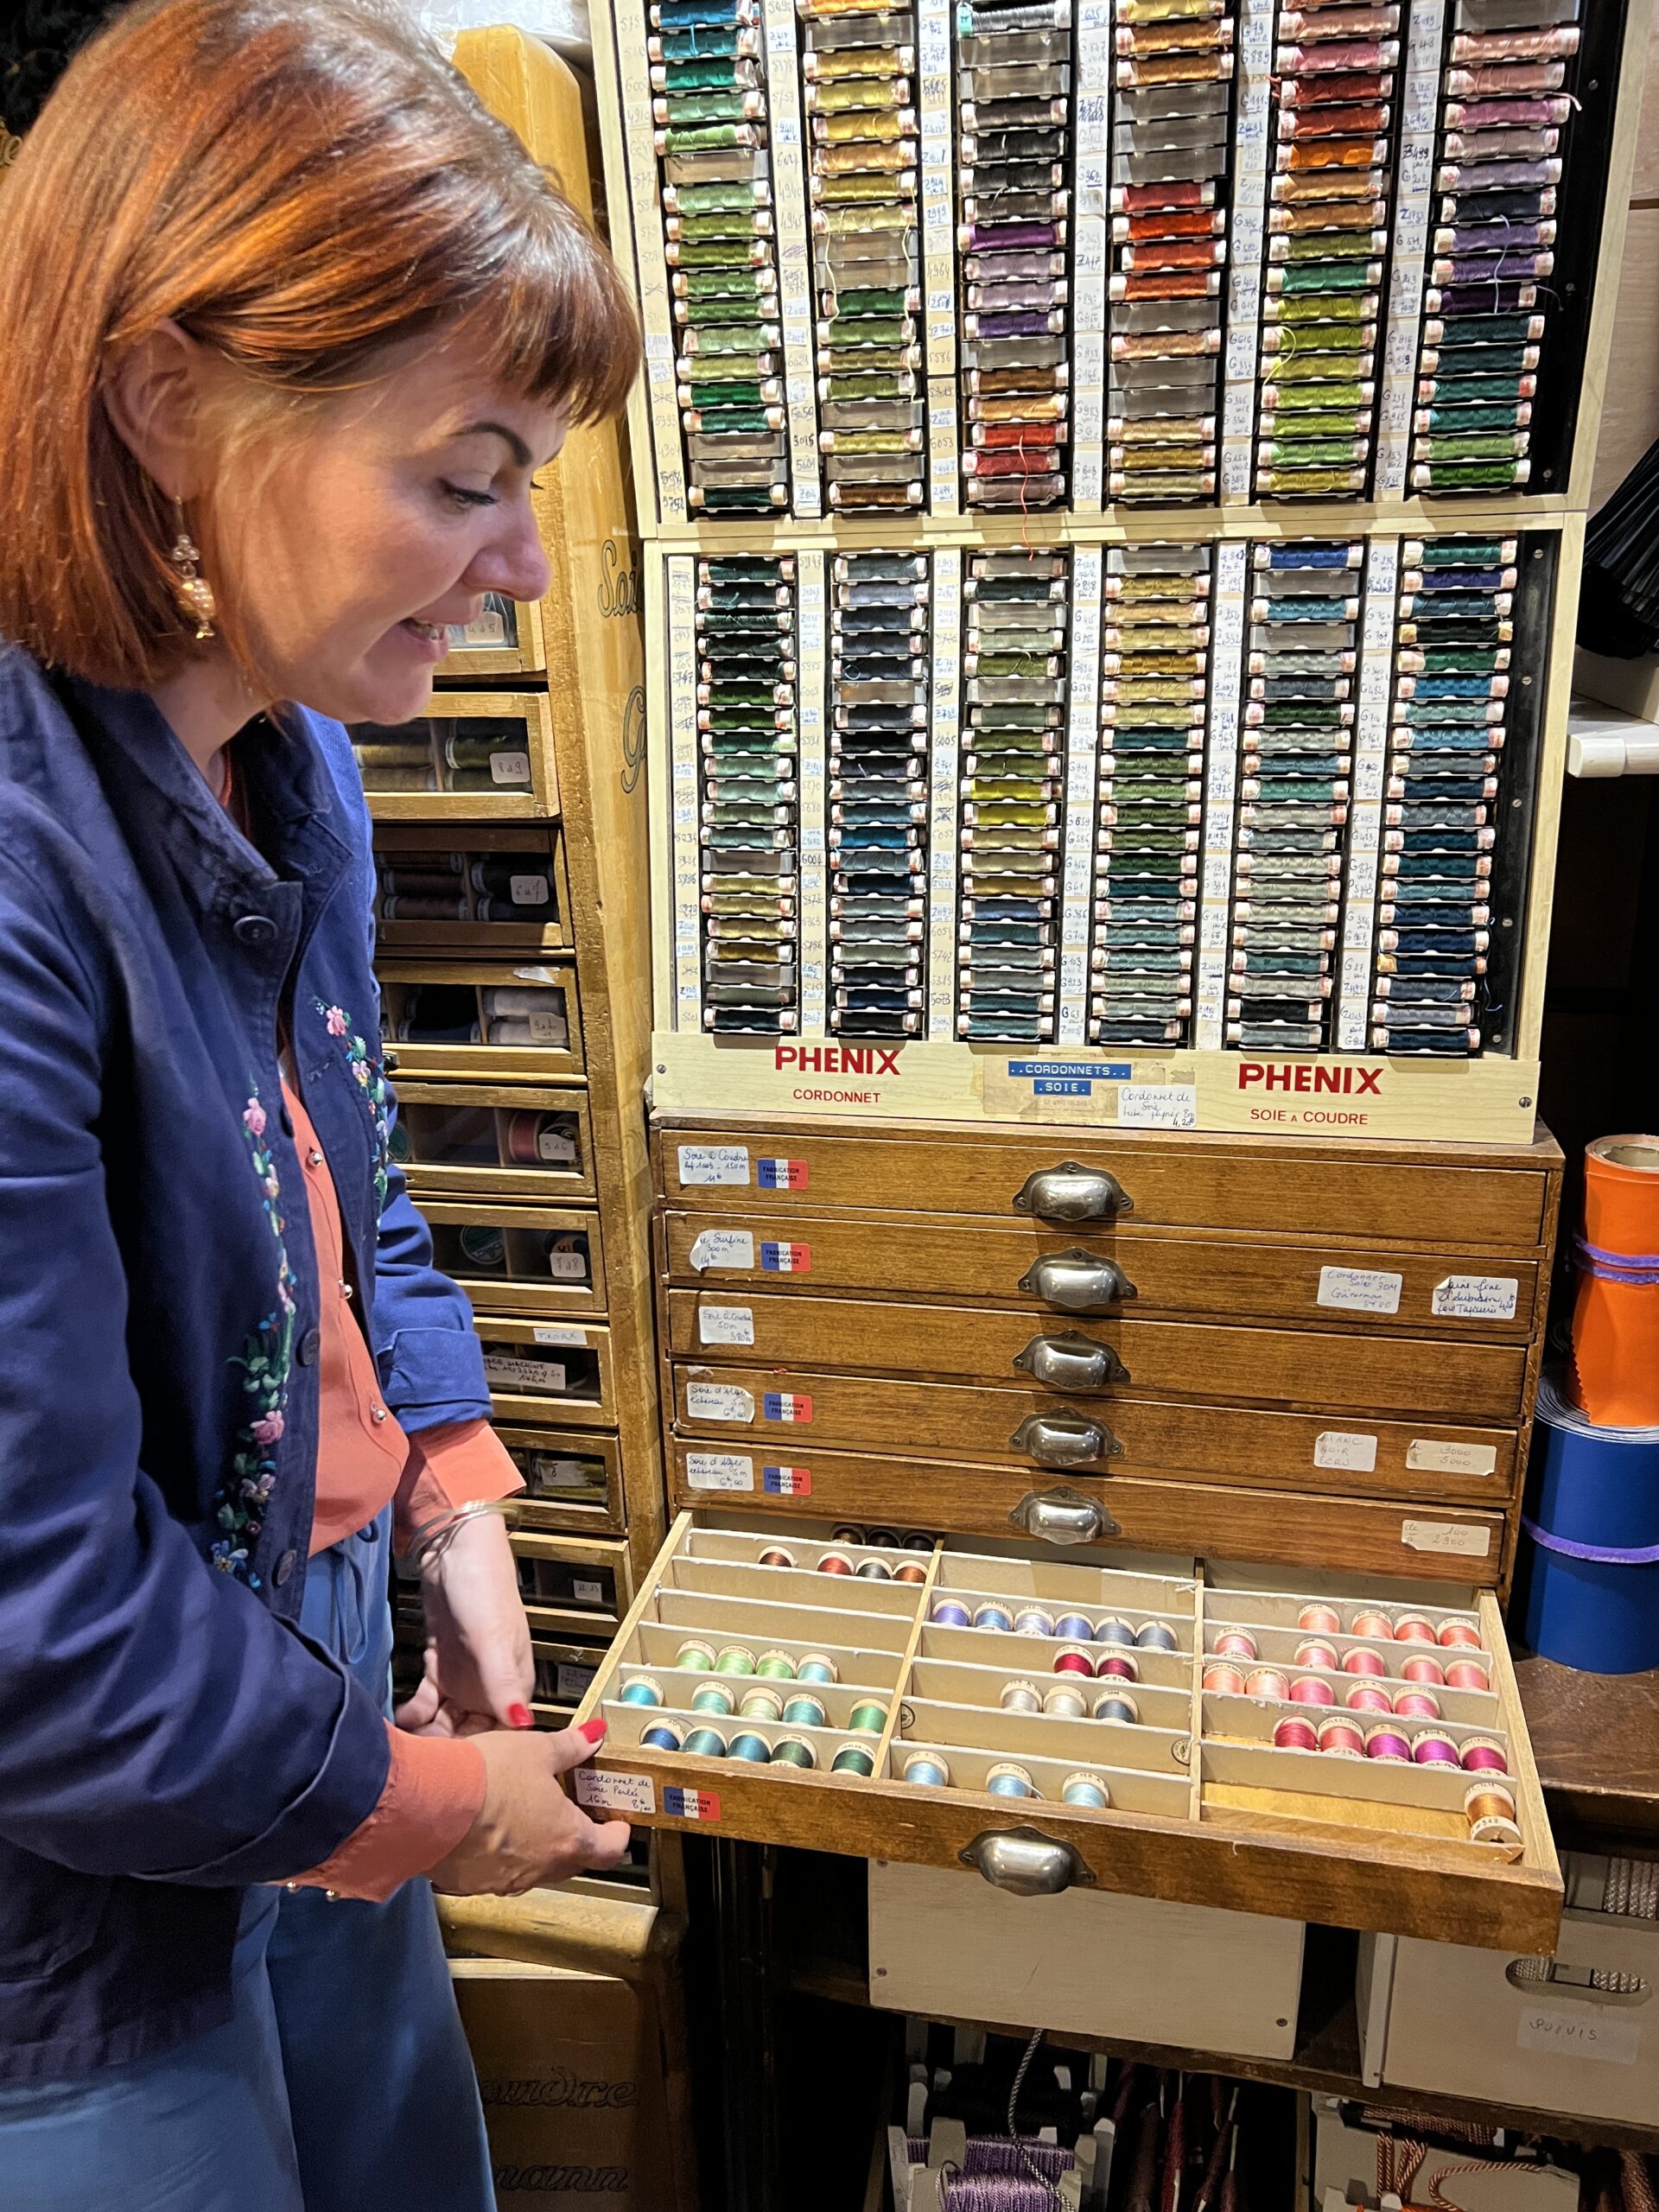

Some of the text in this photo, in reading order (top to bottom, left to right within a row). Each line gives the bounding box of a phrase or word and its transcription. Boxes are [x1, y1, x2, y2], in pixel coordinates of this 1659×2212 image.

[597, 539, 645, 618] Soi
[775, 1046, 901, 1075] PHENIX
[1238, 1064, 1384, 1095] PHENIX
[793, 1089, 880, 1103] CORDONNET
[1122, 1086, 1191, 1103] Cordonnet de
[1251, 1109, 1287, 1122] SOIE
[1303, 1111, 1369, 1125] COUDRE
[683, 1147, 705, 1160] Soie
[719, 1149, 749, 1162] Coudre
[766, 1173, 798, 1182] FRANÇAISE
[769, 1256, 800, 1265] FRANÇAISE
[769, 1401, 804, 1409] FABRICATION
[772, 1408, 802, 1416] FRANÇAISE
[1440, 1456, 1471, 1467] 5000
[768, 1473, 804, 1482] FABRICATION
[771, 1481, 801, 1490] FRANÇAISE
[579, 1770, 651, 1789] Cordonnet de
[669, 1794, 711, 1806] FABRICATION
[672, 1802, 709, 1813] FRANÇAISE
